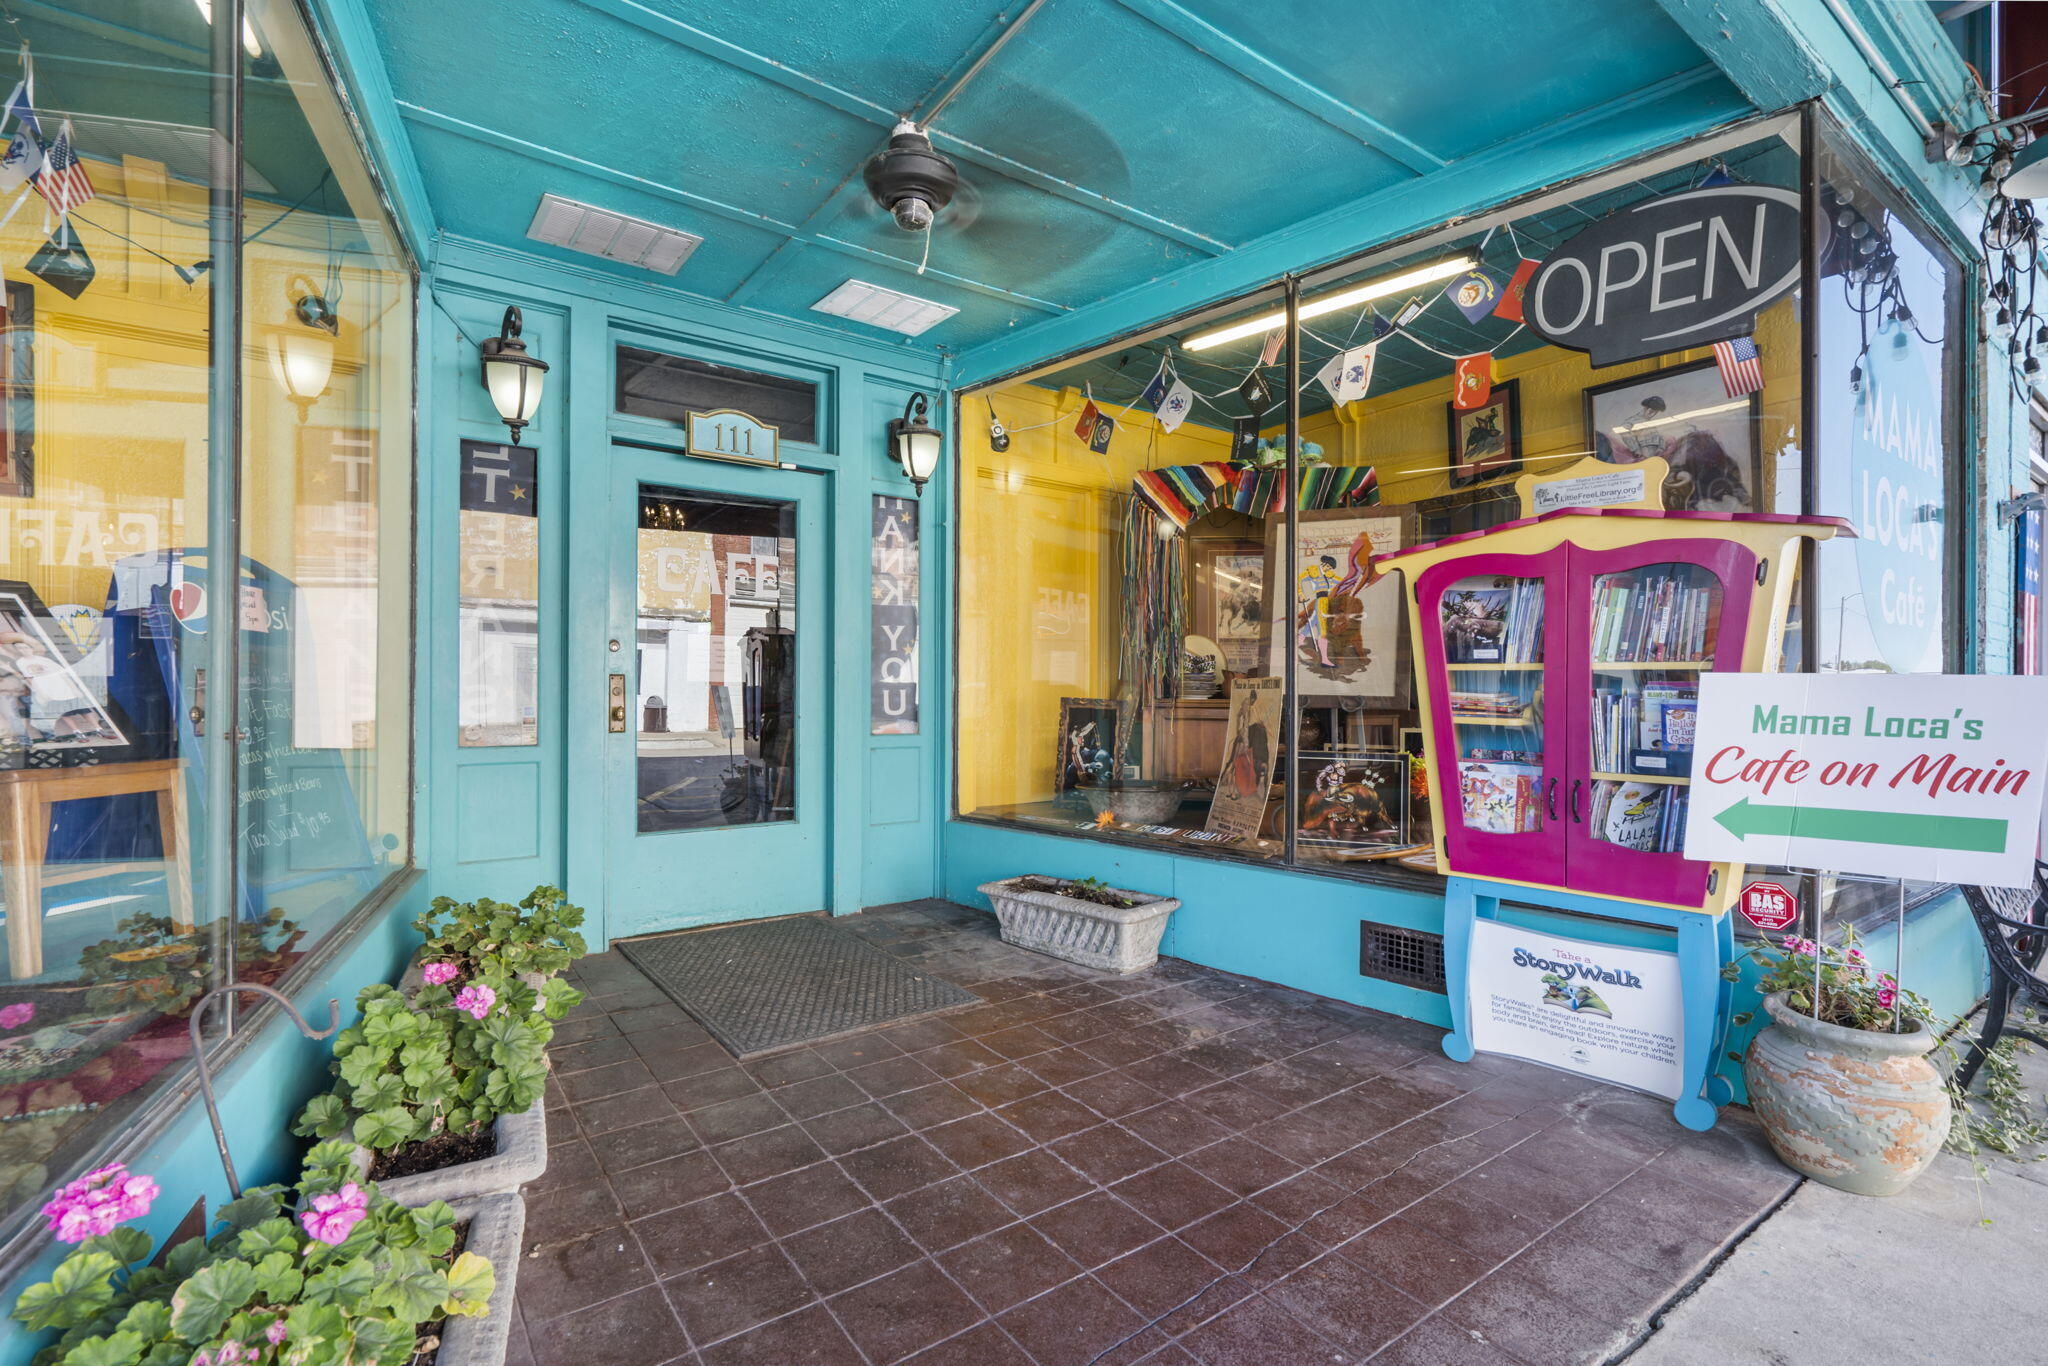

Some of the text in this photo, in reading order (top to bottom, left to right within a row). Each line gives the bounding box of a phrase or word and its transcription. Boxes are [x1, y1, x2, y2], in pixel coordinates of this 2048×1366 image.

[1534, 203, 1766, 336] OPEN
[714, 423, 754, 456] 111
[1863, 374, 1938, 478] MAMA
[1560, 487, 1637, 502] LittleFreeLibrary.org
[656, 547, 780, 599] CAFE
[1751, 703, 1984, 741] Mama Loca's
[1704, 745, 2031, 799] Cafe on Main
[1750, 893, 1785, 911] BAS
[1512, 946, 1643, 989] StoryWalk
[1552, 948, 1592, 964] Take a
[1491, 1007, 1674, 1057] body and brain, and read! Explore nature while
[1491, 1015, 1505, 1023] you
[1507, 1018, 1527, 1028] share
[1539, 1027, 1575, 1042] engaging
[1576, 1036, 1597, 1046] book
[1599, 1042, 1618, 1051] with
[1619, 1047, 1638, 1056] your
[1640, 1051, 1678, 1066] children.
[1503, 1003, 1531, 1016] families
[1541, 1015, 1562, 1026] enjoy
[1563, 1020, 1577, 1028] the
[1619, 1034, 1654, 1045] exercise
[1656, 1041, 1677, 1051] your
[1536, 1007, 1549, 1015] are
[1550, 1010, 1587, 1025] delightful
[1588, 1020, 1604, 1028] and
[1605, 1024, 1650, 1037] innovative
[1651, 1032, 1674, 1044] ways
